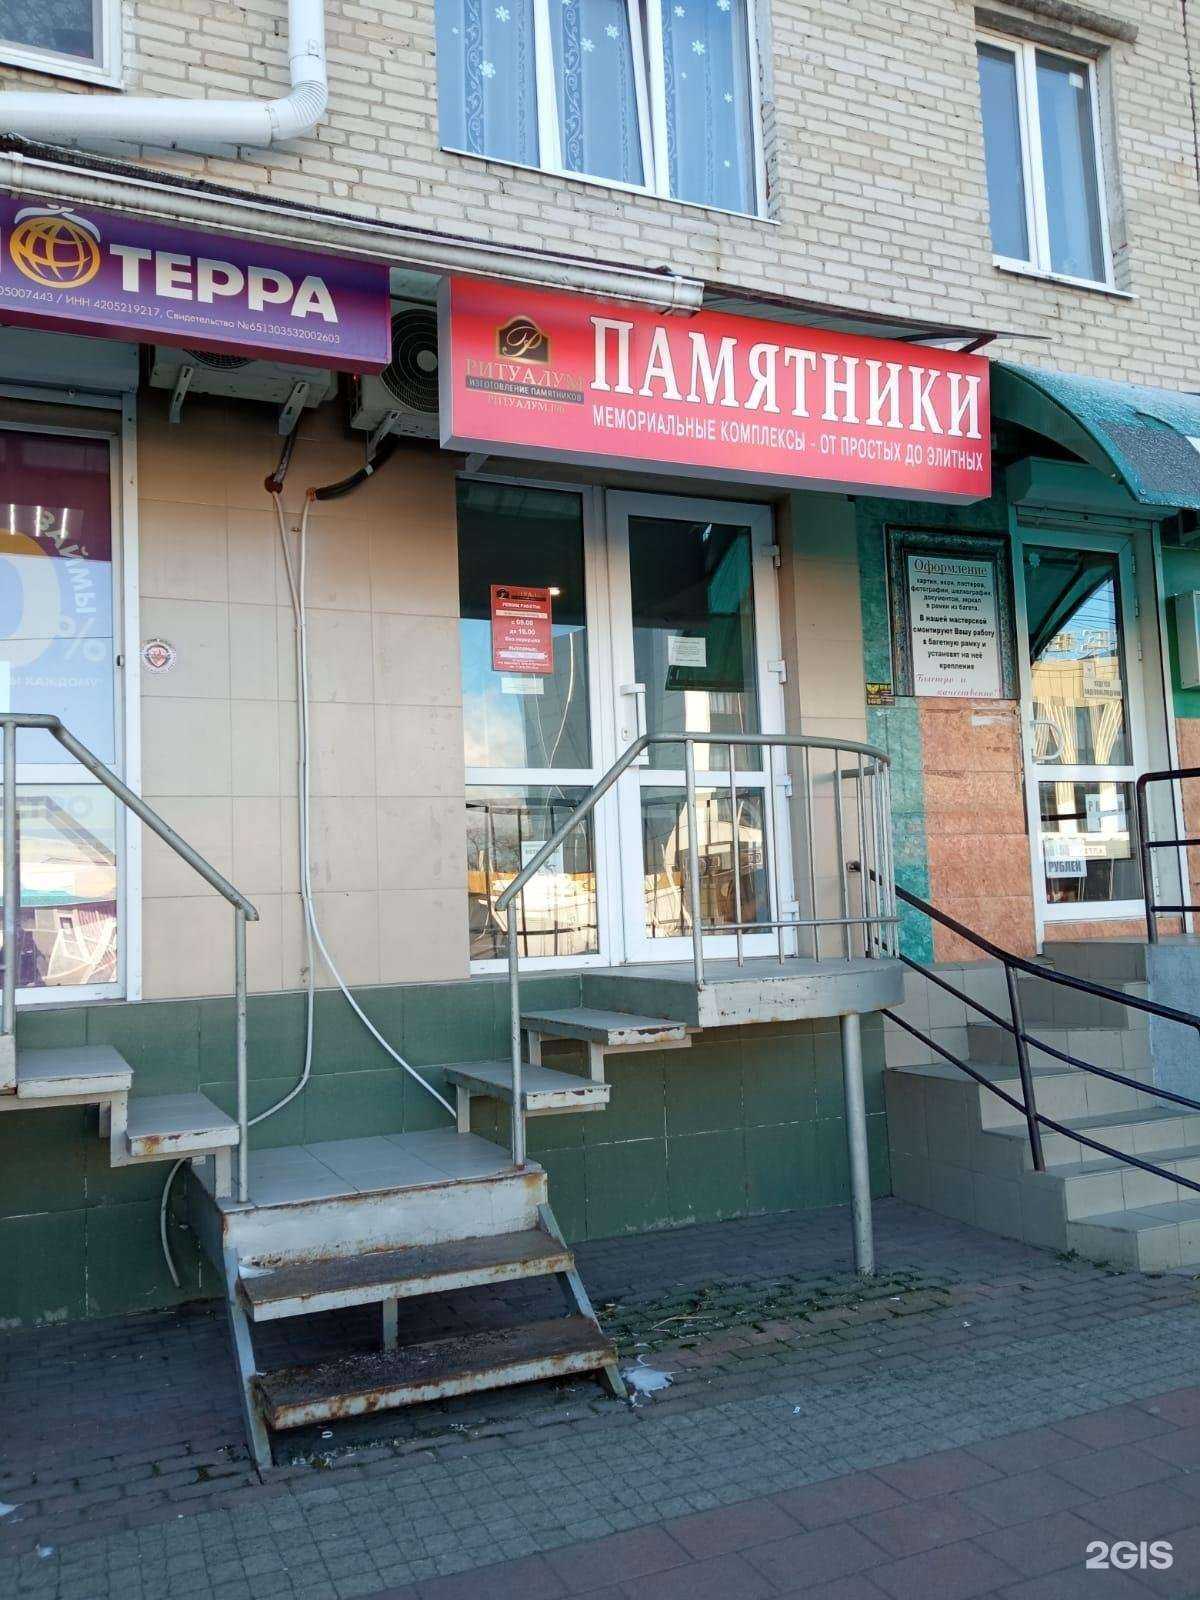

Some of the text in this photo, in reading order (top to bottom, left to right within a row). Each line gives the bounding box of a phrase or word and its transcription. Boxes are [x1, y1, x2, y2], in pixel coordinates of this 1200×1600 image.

[109, 244, 339, 323] ТЕРРА
[166, 309, 235, 329] Свидетельство
[465, 358, 583, 391] РИТУАЛУМ
[589, 315, 983, 440] ПАМЯТНИКИ
[468, 378, 582, 402] ИЗГОТОВЛЕНИЕ ПАМЯТНИКОВ
[592, 404, 717, 441] МЕМОРИАЛЬНЫЕ
[720, 420, 806, 452] КОМПЛЕКСЫ
[820, 433, 837, 454] ОТ
[841, 435, 901, 462] ПРОСТЫХ
[905, 443, 923, 467] ДО
[927, 446, 984, 472] ЭЛИТНЫХ
[914, 559, 988, 575] Оформление
[926, 615, 948, 623] нашей
[949, 617, 987, 625] мастерской
[913, 627, 953, 635] смонтируют
[973, 629, 995, 638] работу
